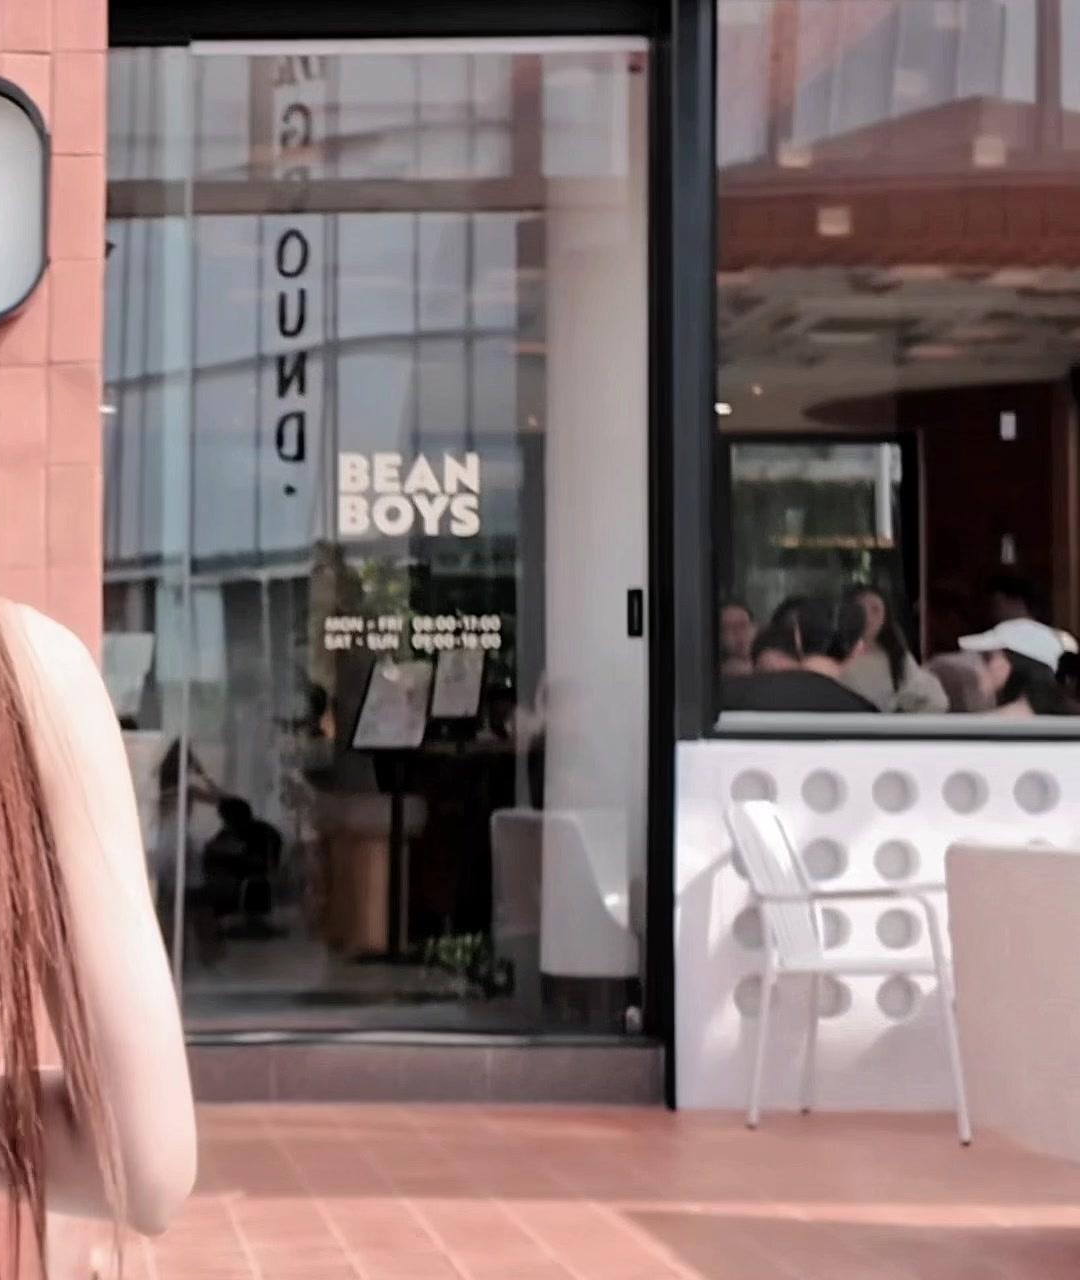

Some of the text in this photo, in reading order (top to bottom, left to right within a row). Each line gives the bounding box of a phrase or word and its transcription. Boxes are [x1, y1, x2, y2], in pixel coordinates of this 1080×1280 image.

[338, 451, 481, 494] BEAN
[338, 494, 481, 537] BOYS
[324, 615, 364, 633] MON
[324, 632, 352, 650] SAT
[366, 632, 400, 650] SUN
